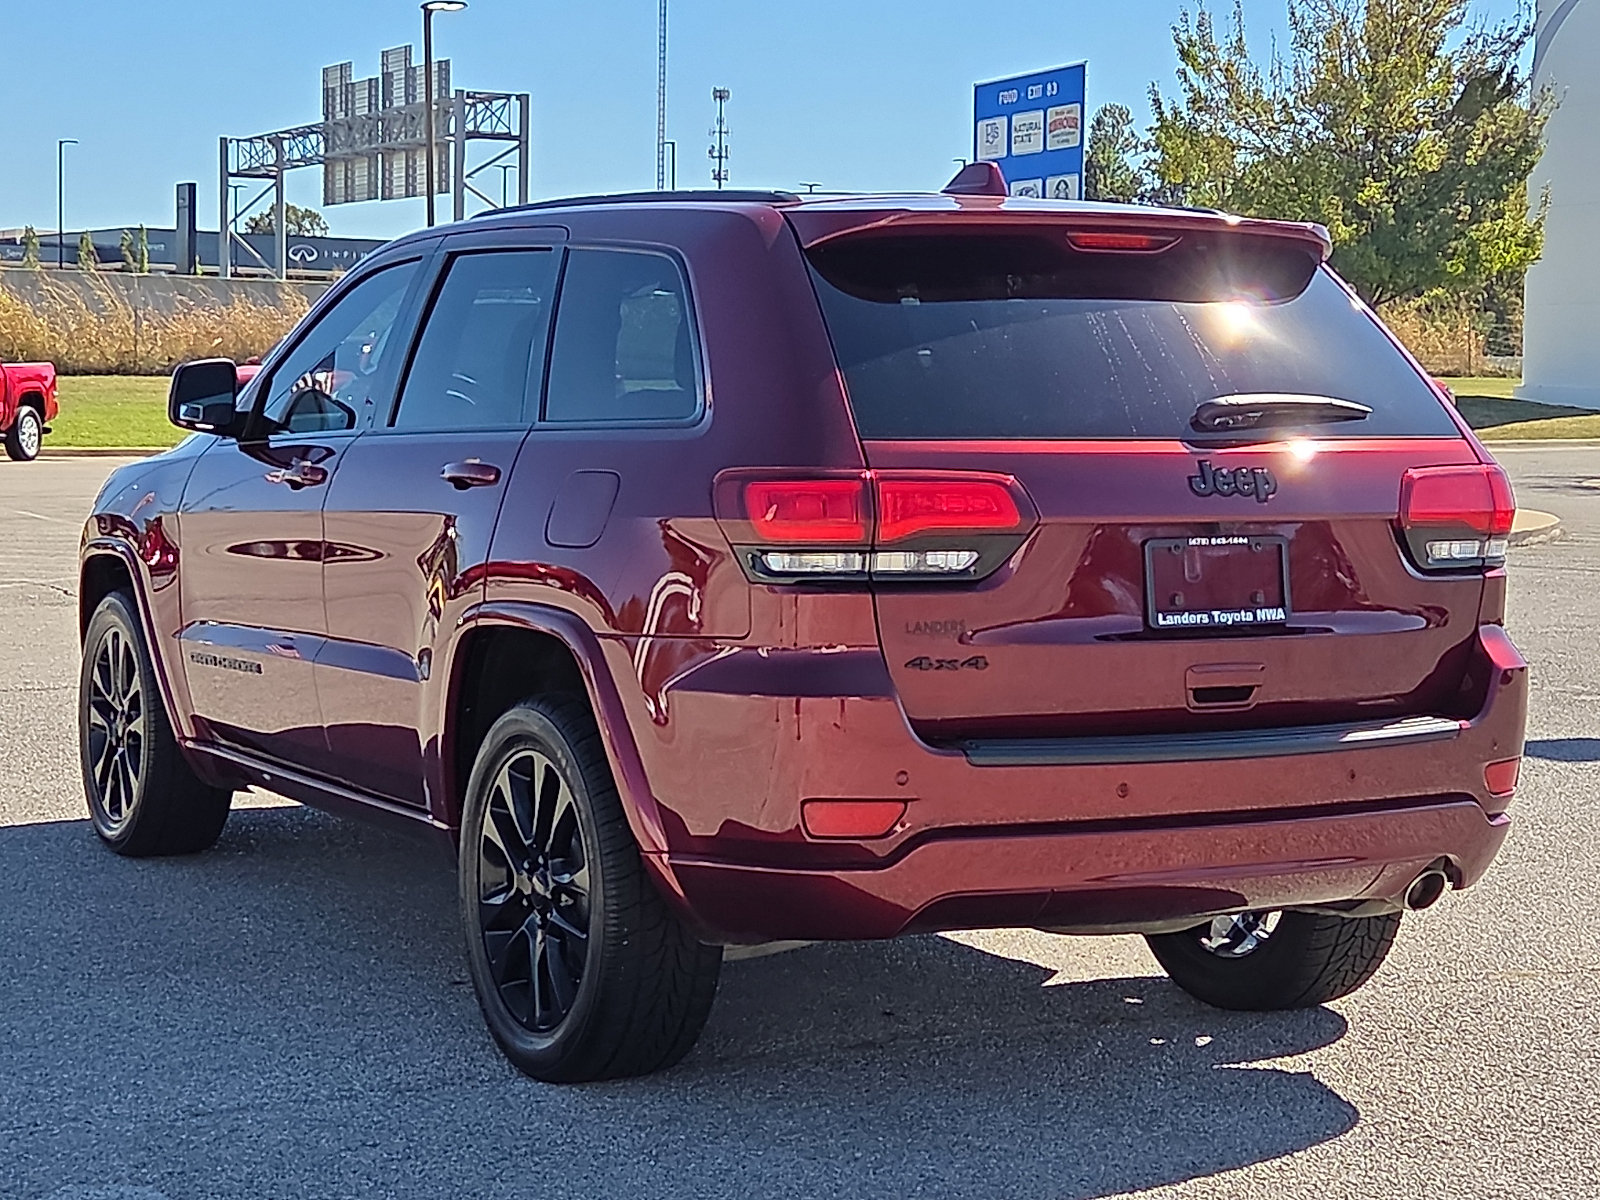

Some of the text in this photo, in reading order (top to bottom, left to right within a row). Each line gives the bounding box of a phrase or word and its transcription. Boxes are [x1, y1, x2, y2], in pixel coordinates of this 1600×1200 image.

[1186, 459, 1278, 504] Jeep
[1158, 607, 1286, 626] Landers Toyota NWA
